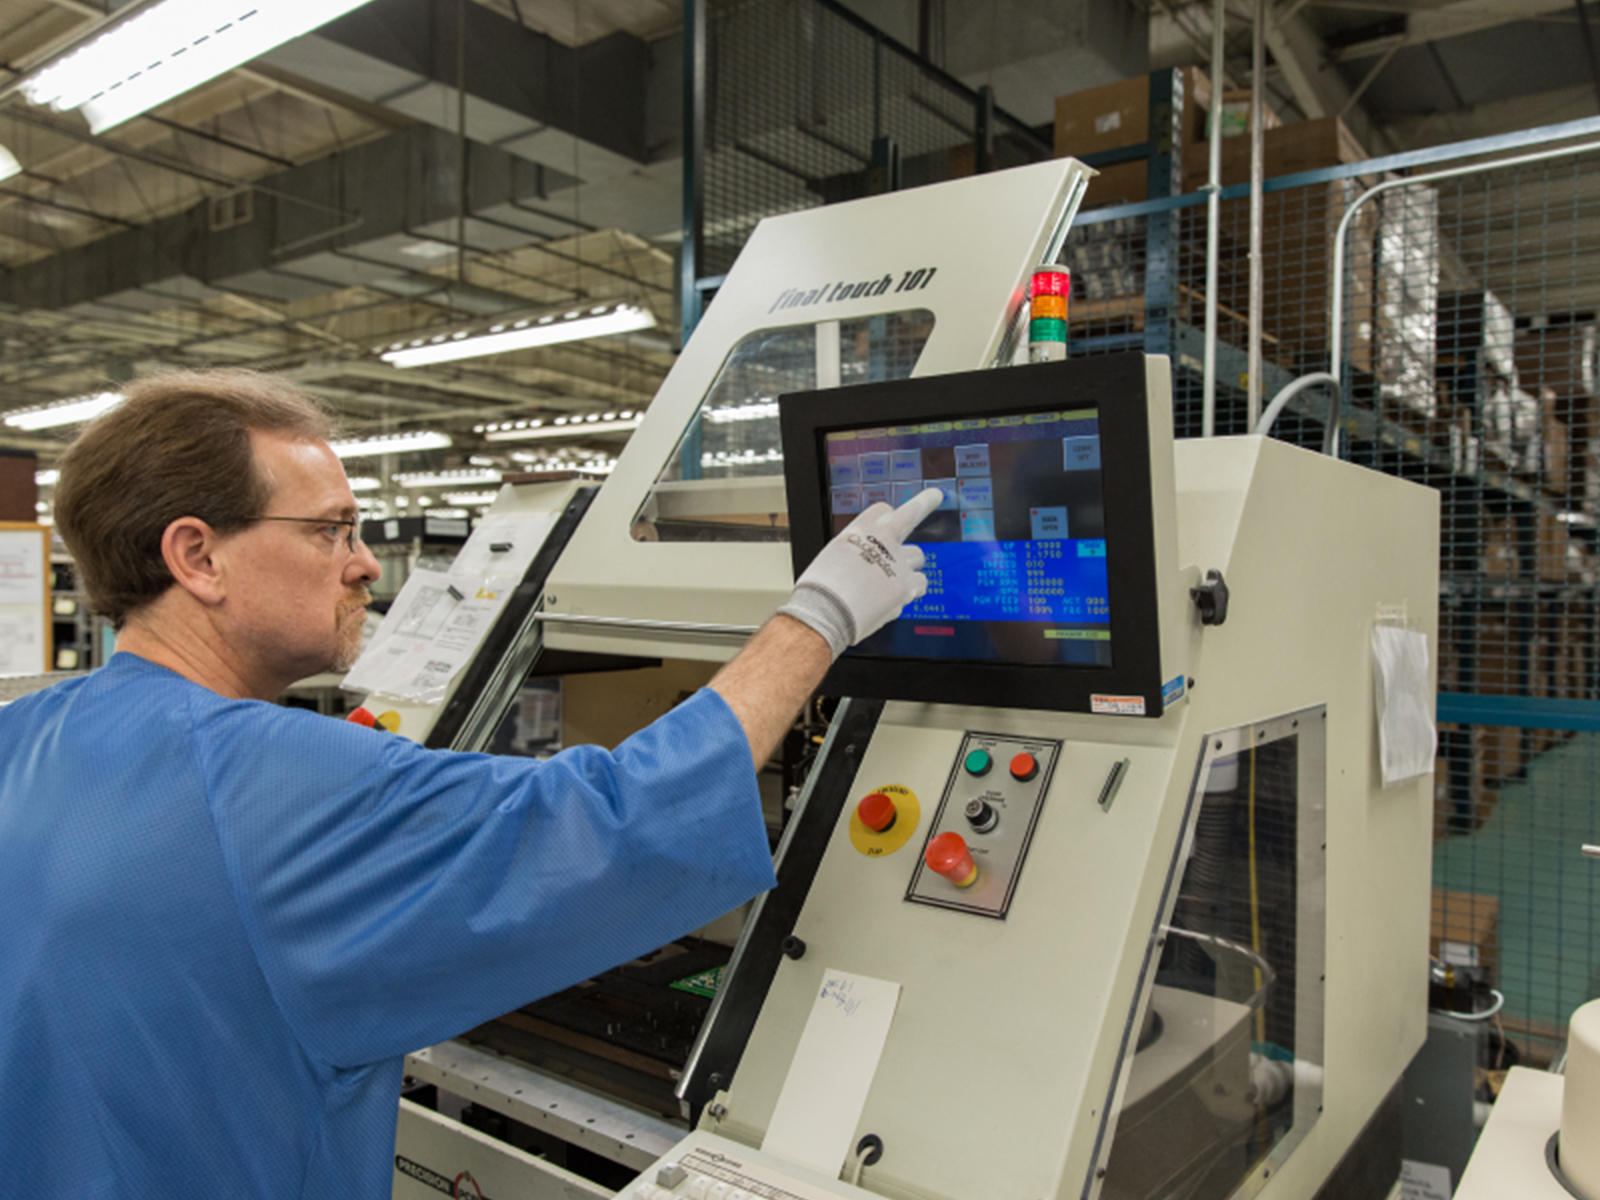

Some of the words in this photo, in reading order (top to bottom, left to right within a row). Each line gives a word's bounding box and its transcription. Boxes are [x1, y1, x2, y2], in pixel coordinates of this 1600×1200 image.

[768, 283, 832, 314] final
[826, 274, 893, 303] touch
[894, 267, 937, 293] 101
[983, 559, 1017, 569] INFEED
[977, 570, 1017, 578] RETRACT
[995, 595, 1019, 605] FEED
[1029, 596, 1047, 605] 100
[398, 1159, 451, 1193] PRECISION
